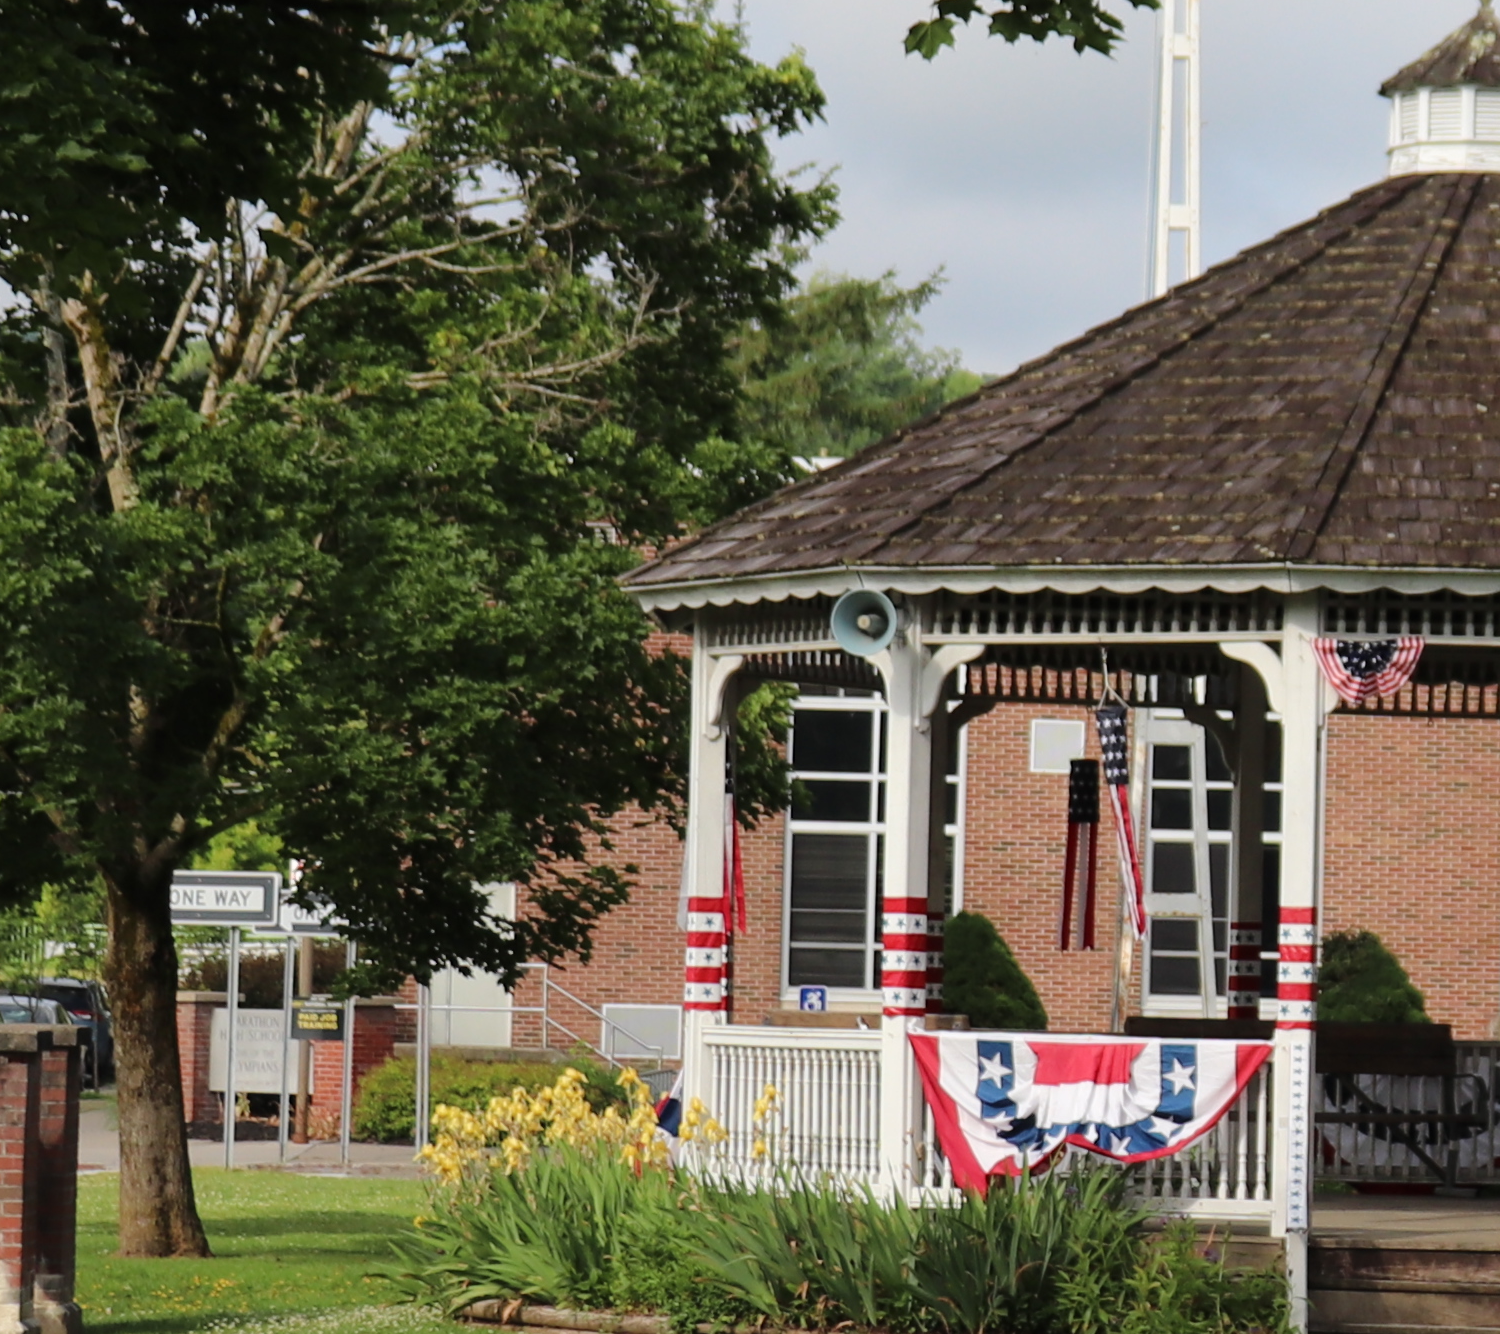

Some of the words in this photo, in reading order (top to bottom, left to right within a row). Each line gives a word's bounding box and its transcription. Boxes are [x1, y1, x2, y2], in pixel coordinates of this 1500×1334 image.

[170, 889, 206, 906] ONE
[214, 889, 252, 907] WAY
[237, 1015, 280, 1028] ARATHON
[298, 1013, 318, 1022] PAID
[320, 1013, 337, 1022] JOB
[297, 1020, 338, 1030] TRAINING
[220, 1029, 244, 1041] HH
[238, 1061, 279, 1073] YMPIANS
